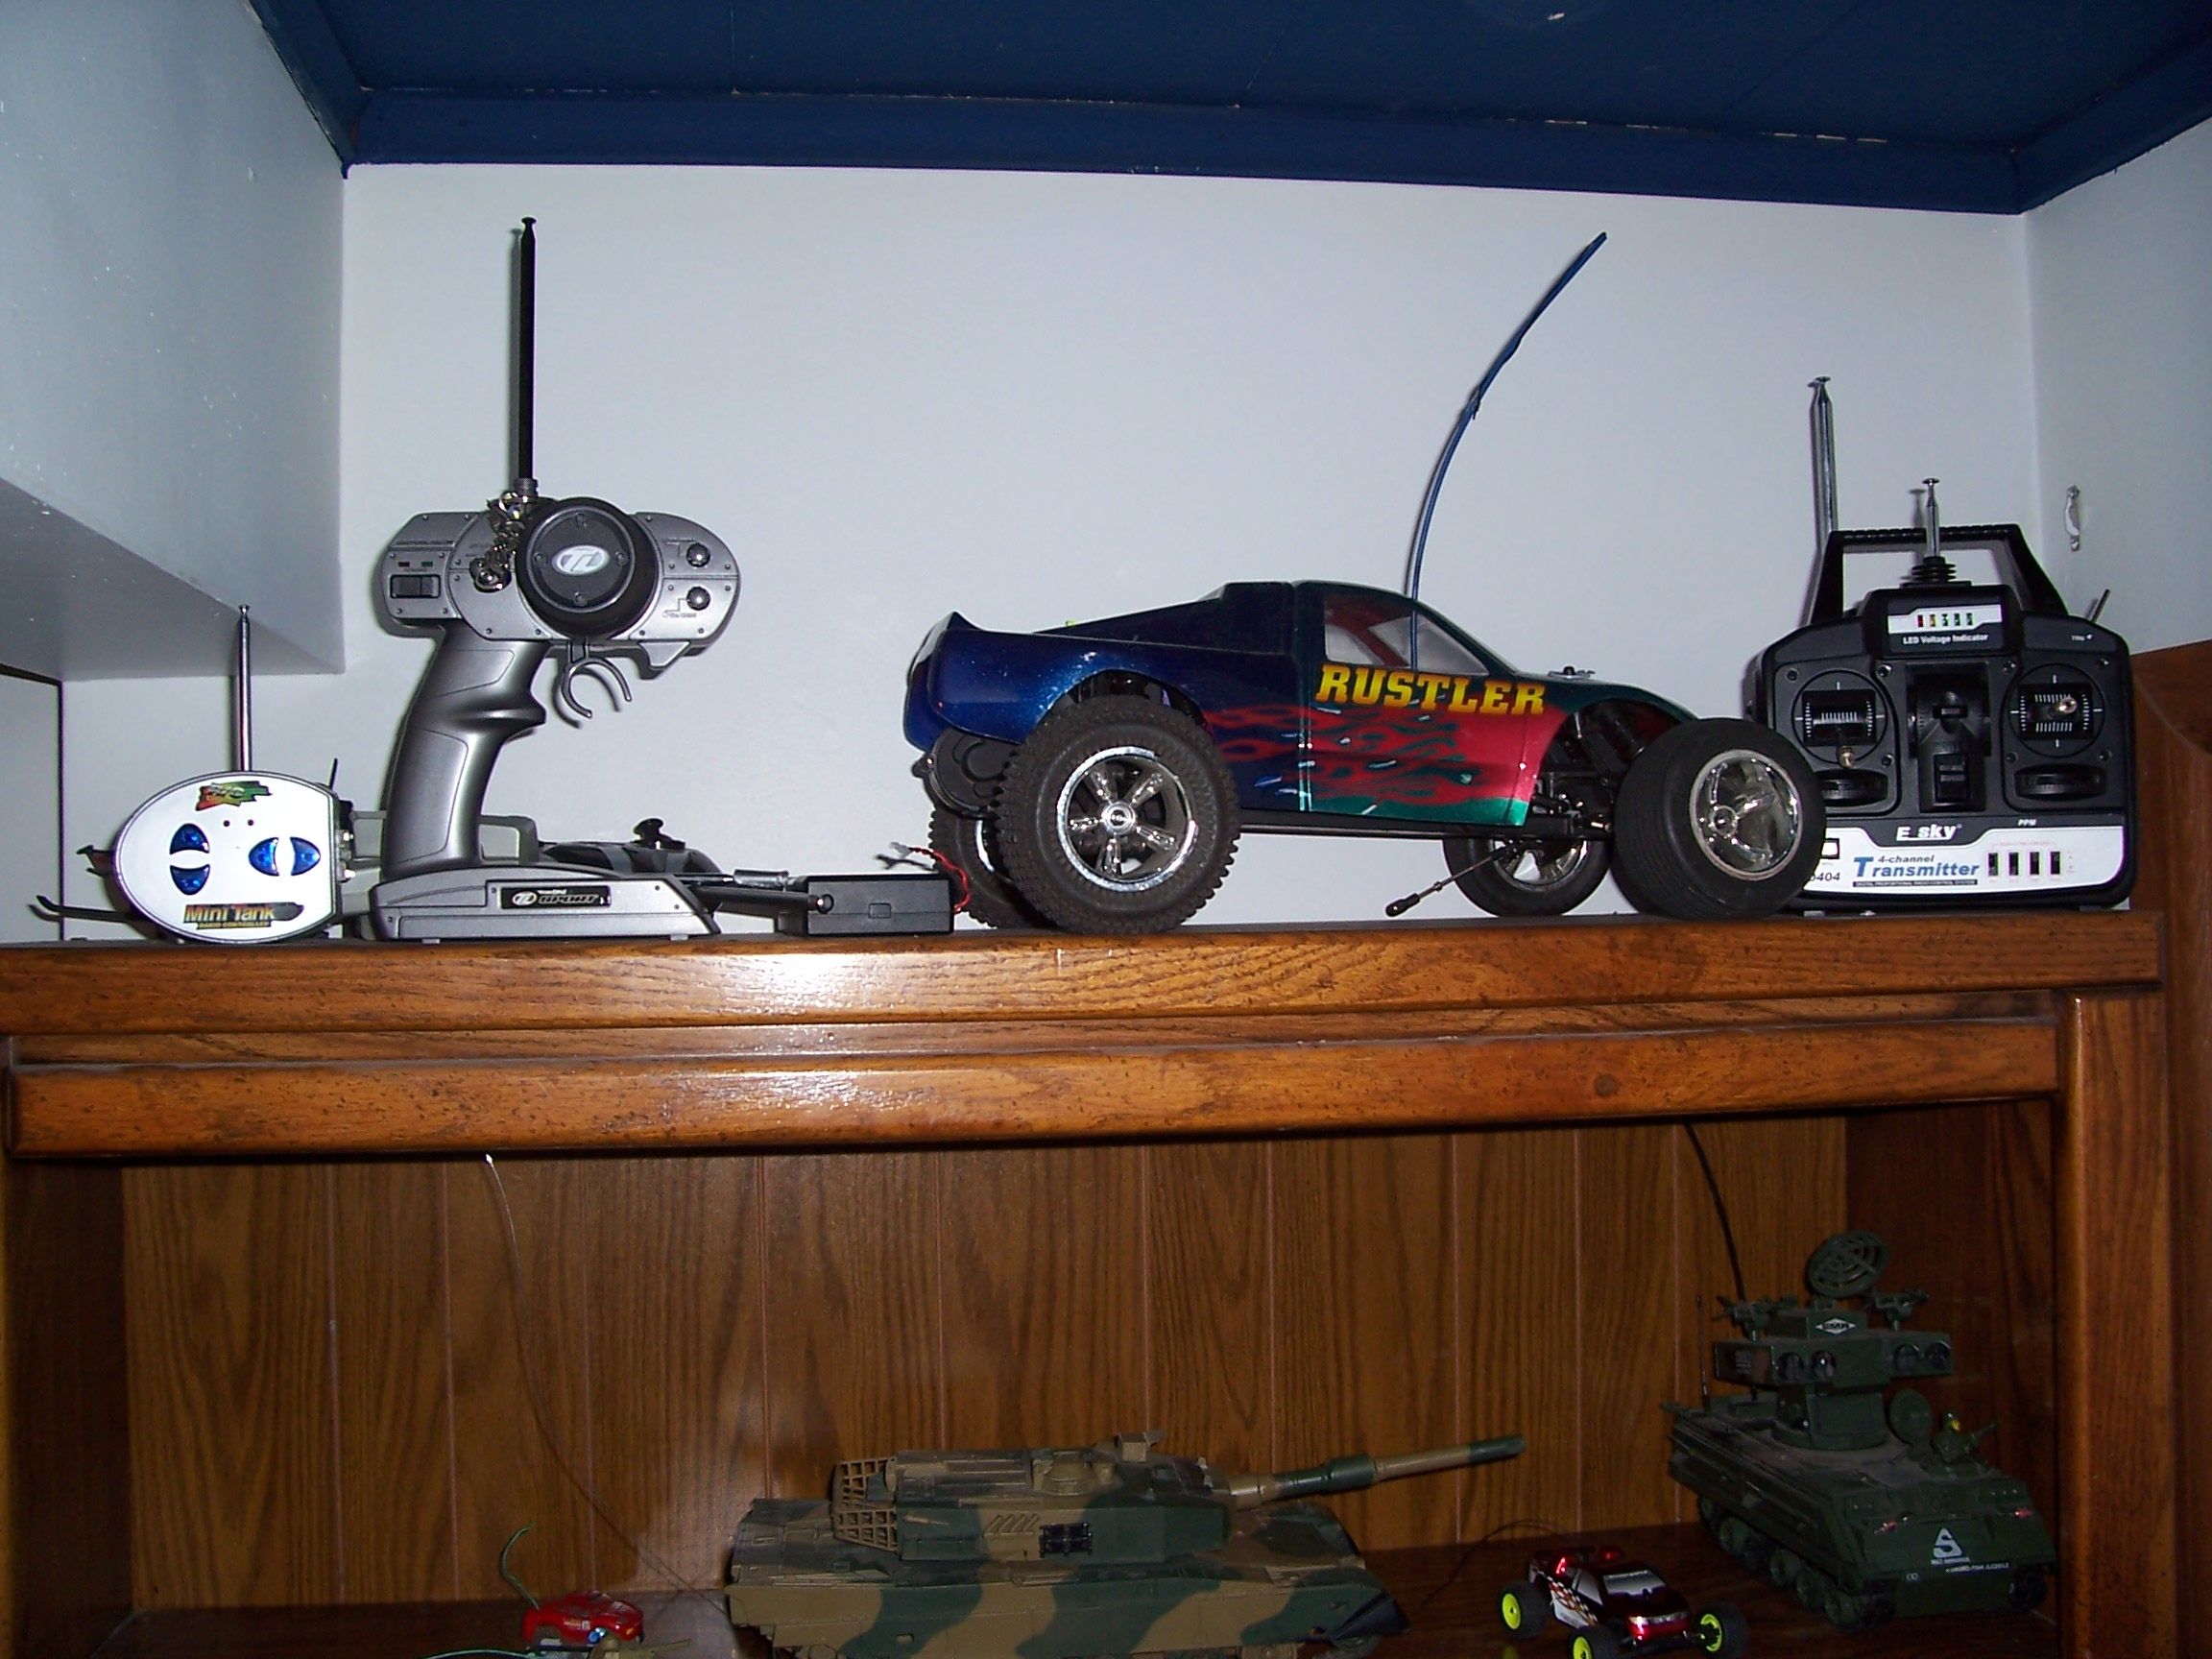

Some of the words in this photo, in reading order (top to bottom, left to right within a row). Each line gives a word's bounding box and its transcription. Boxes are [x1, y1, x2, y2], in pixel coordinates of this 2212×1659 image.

[1902, 635, 1919, 645] LED
[1920, 635, 1952, 645] Voltage
[1952, 633, 1988, 643] Indicator
[1315, 662, 1547, 716] RUSTLER
[1853, 855, 1980, 878] Transmitter
[1878, 854, 1935, 864] 4-channel
[185, 904, 229, 923] Mini
[231, 904, 276, 922] Tank
